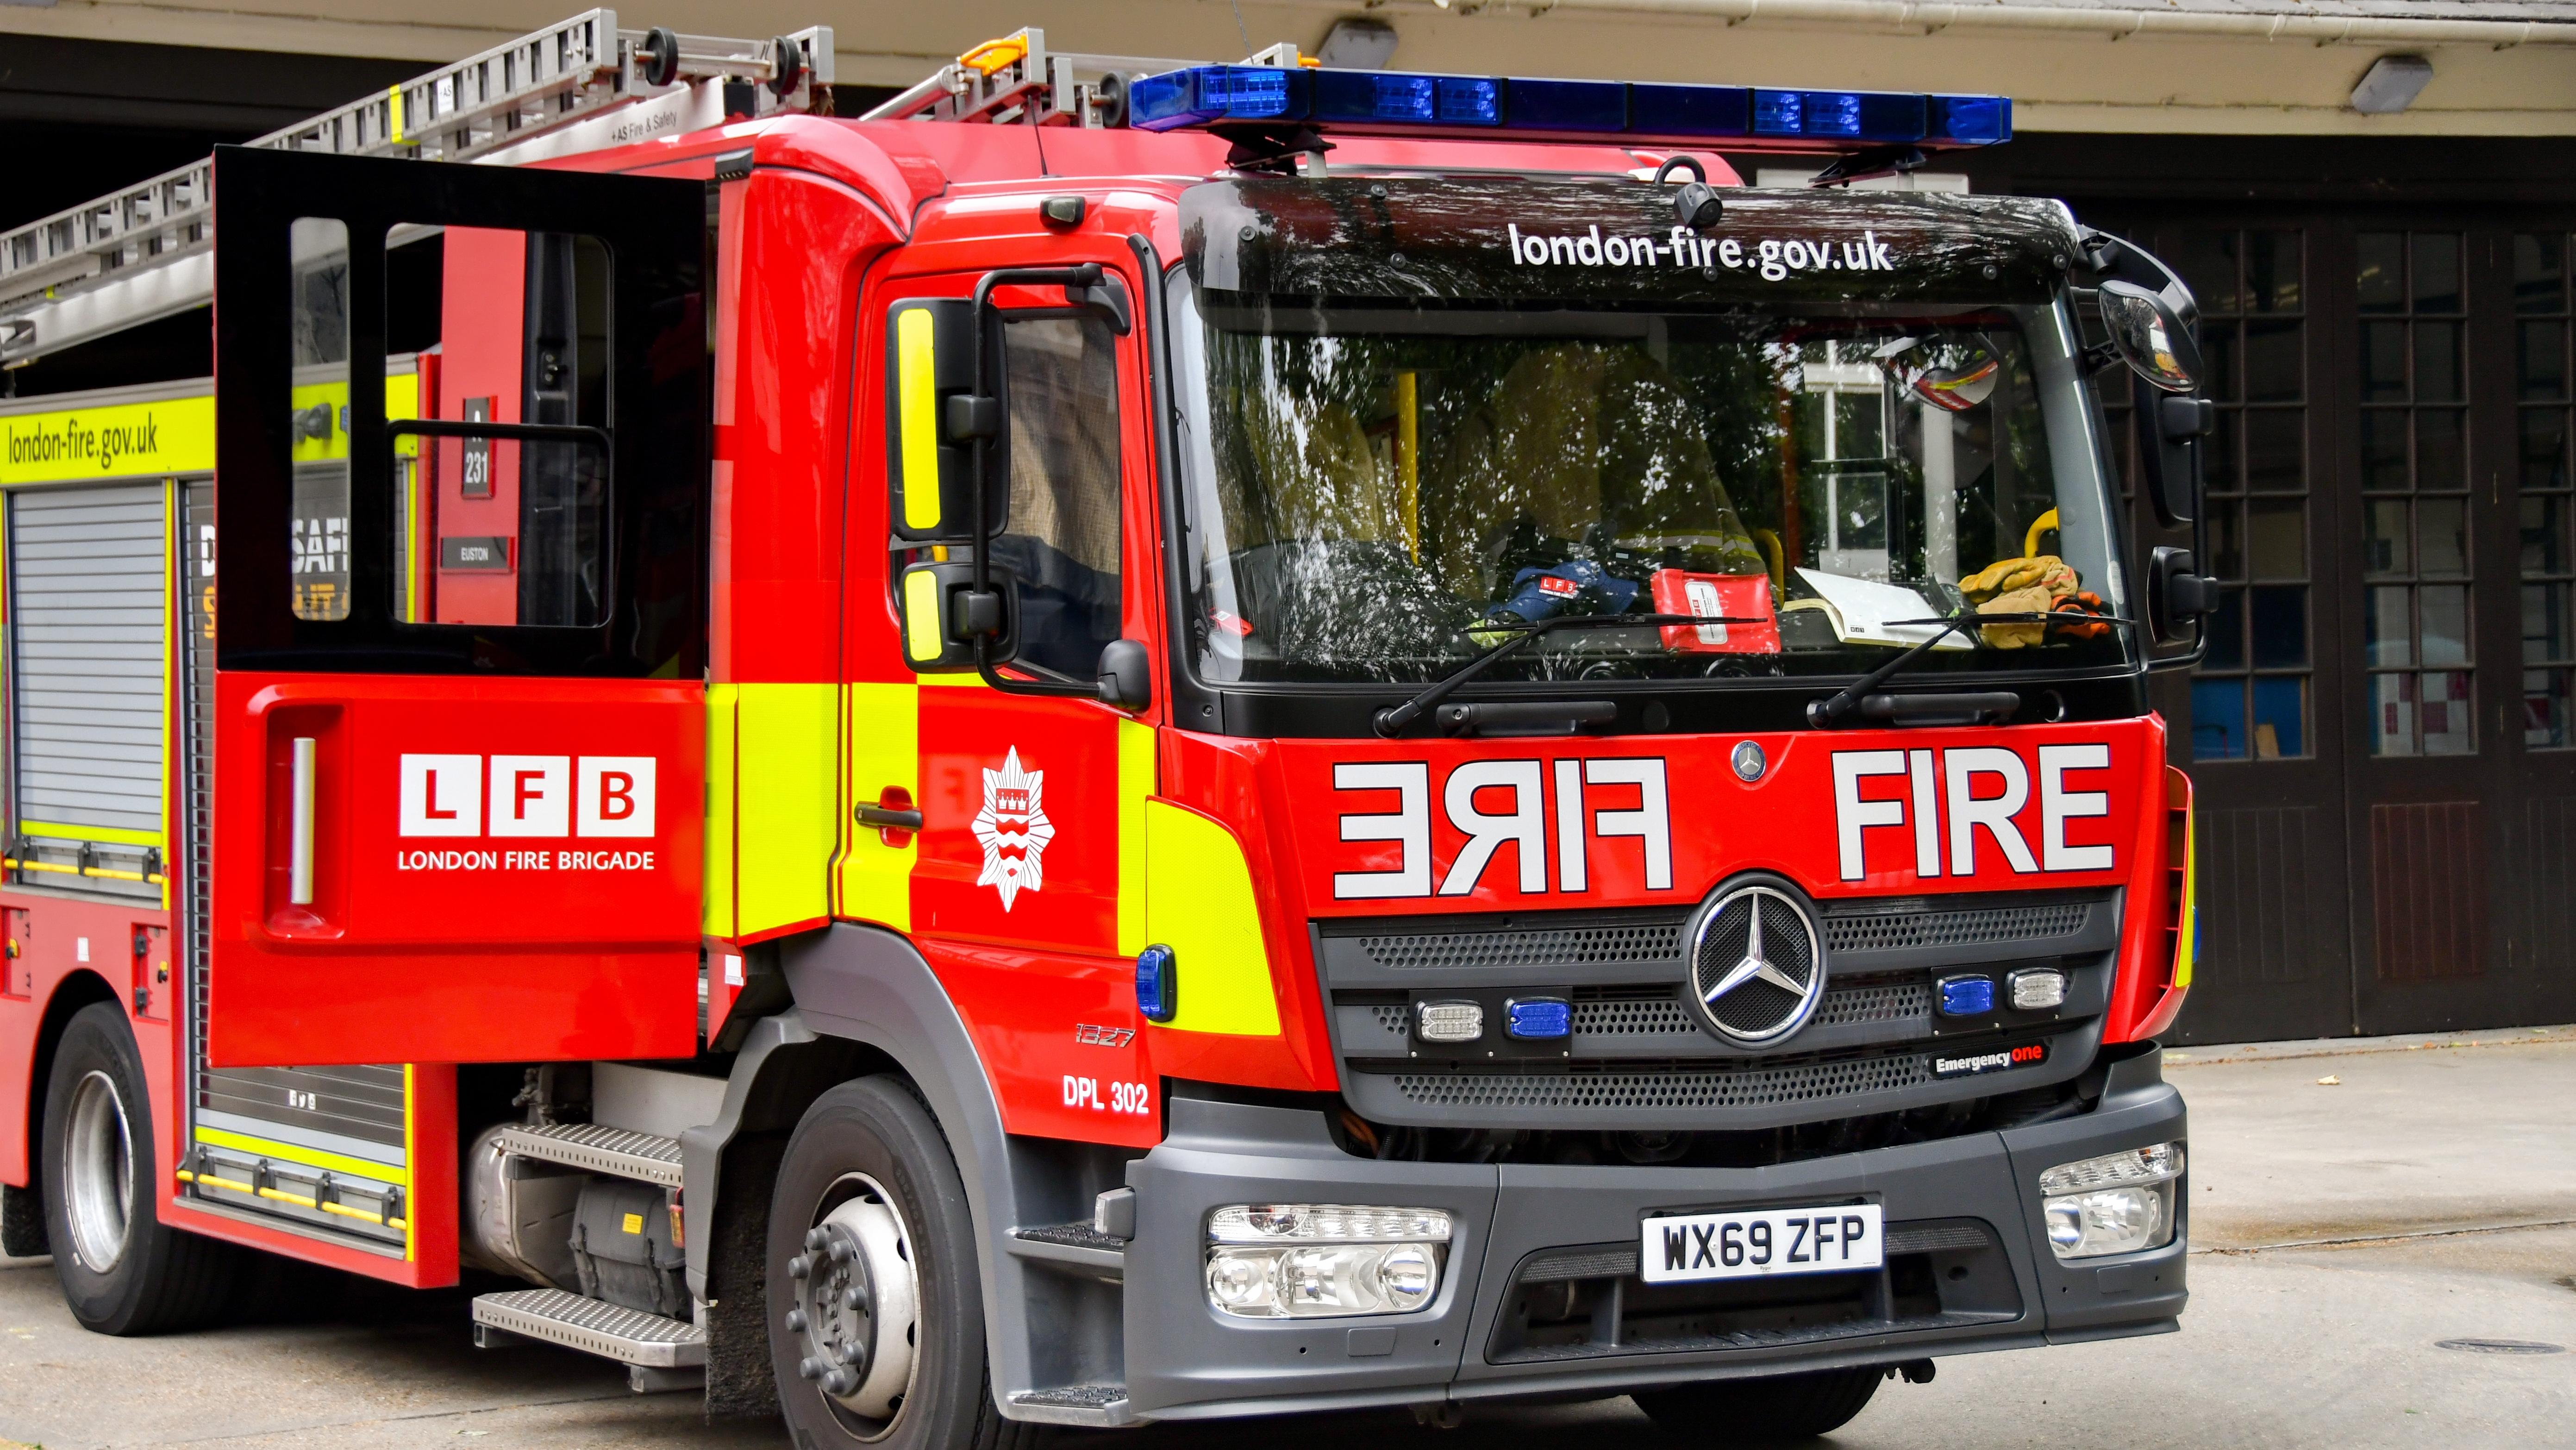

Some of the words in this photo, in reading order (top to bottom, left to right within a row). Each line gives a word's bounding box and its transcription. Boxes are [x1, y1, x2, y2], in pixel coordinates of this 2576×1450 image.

[629, 122, 644, 138] Fire
[646, 117, 652, 133] &
[653, 111, 677, 130] Safety
[1507, 223, 1894, 281] london-fire.gov.uk
[8, 412, 158, 470] london-fire.gov.uk
[465, 451, 488, 484] 231
[292, 518, 348, 573] SAF
[461, 547, 488, 562] EUSTON
[1543, 579, 1574, 592] LFB
[425, 769, 634, 820] LFB
[1831, 744, 2113, 881] FIRE
[399, 850, 497, 870] LONDON
[505, 851, 550, 870] FIRE
[558, 851, 655, 870] BRIGADE
[1076, 1023, 1136, 1048] 1327
[1063, 1075, 1105, 1110] DPL
[1111, 1081, 1149, 1114] 302
[1663, 1220, 1772, 1271] WX69
[1786, 1215, 1864, 1263] ZFP
